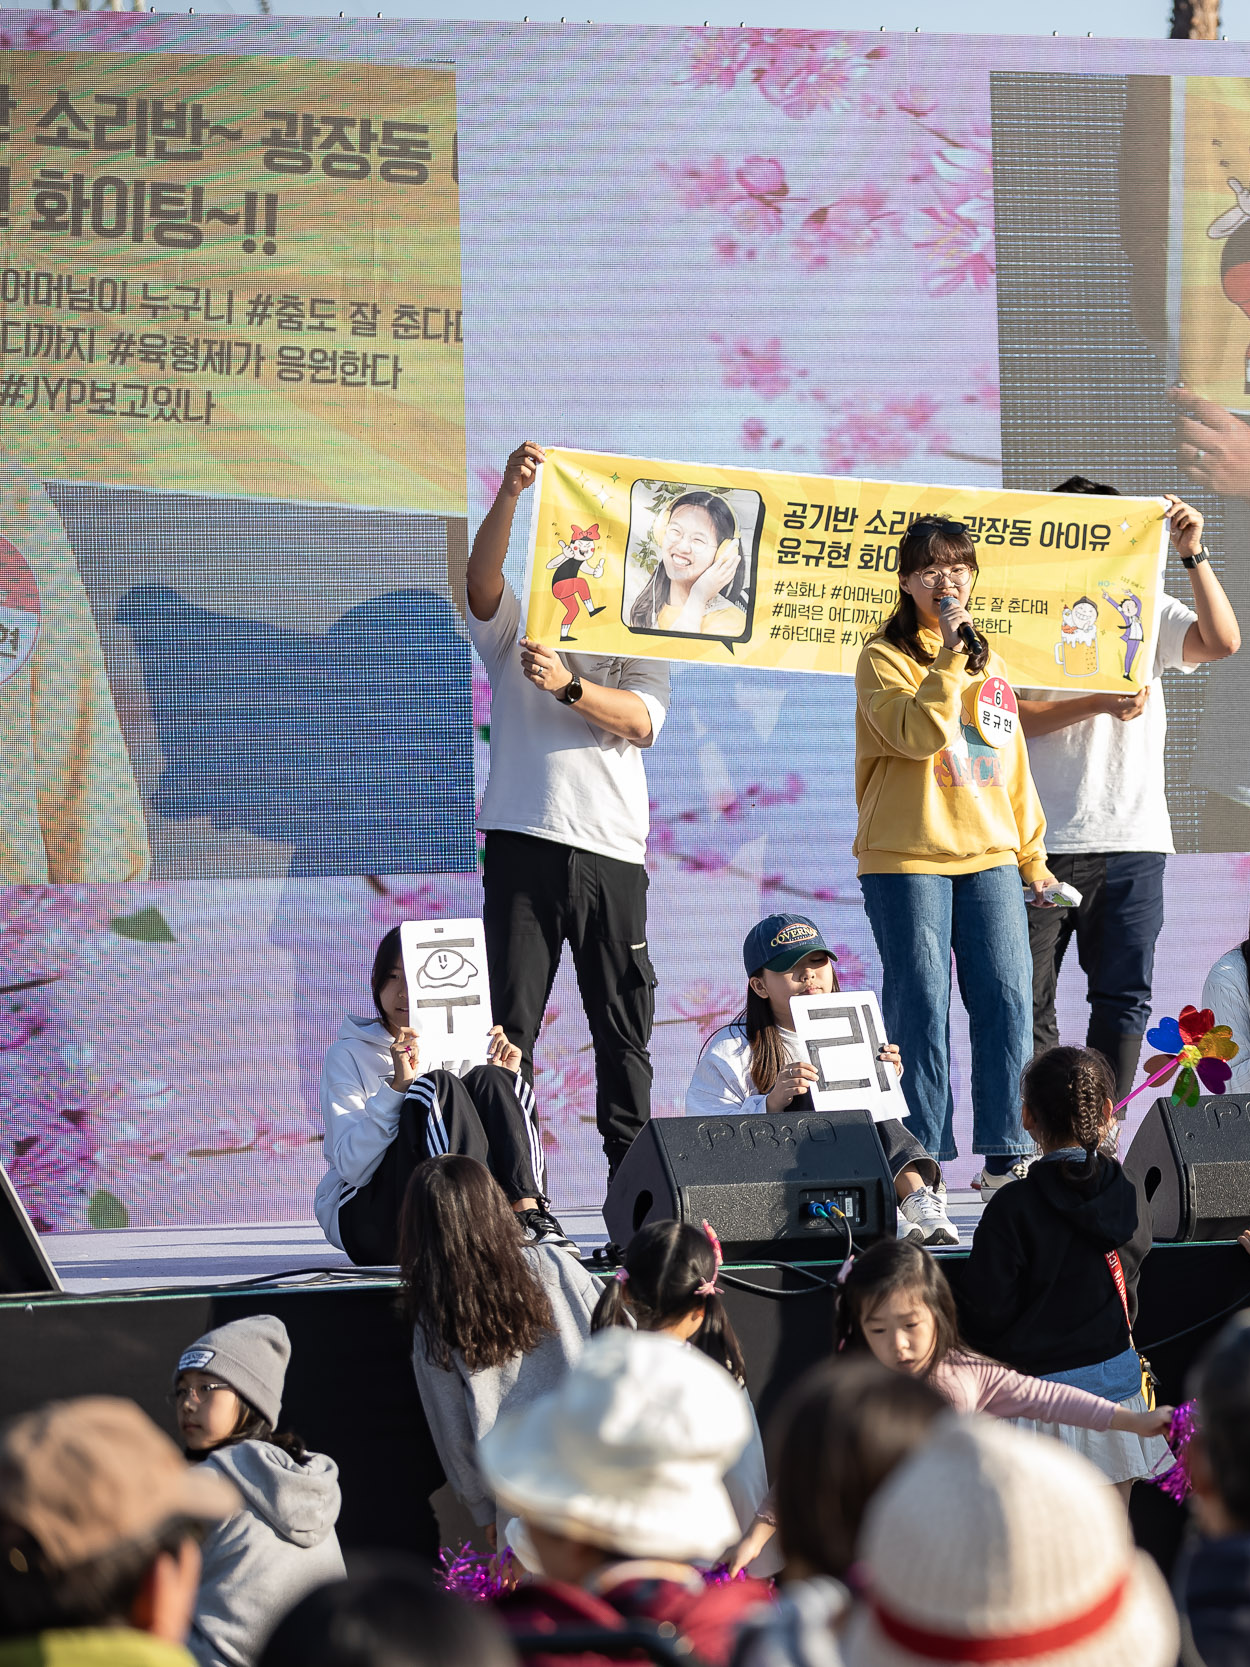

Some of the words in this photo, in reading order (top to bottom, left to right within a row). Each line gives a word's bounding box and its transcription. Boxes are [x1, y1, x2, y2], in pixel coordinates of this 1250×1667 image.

[35, 90, 243, 162] 소리반~
[259, 109, 432, 185] 광장동
[30, 169, 279, 256] 화이팅~!!
[140, 283, 234, 326] 누구니
[246, 293, 337, 333] #춤도
[349, 301, 381, 338] 잘
[108, 332, 266, 379] #육형제가
[276, 345, 402, 390] 응원한다
[0, 374, 216, 424] #JYP보고있나
[783, 501, 859, 533] 공기반
[1039, 521, 1112, 552] 아이유
[777, 537, 852, 569] 윤규현
[771, 602, 824, 621] #매력은
[828, 606, 883, 625] 어디까지
[774, 580, 826, 599] #실화냐
[831, 585, 899, 605] #어머님이
[990, 597, 1005, 613] 잘
[1008, 598, 1048, 615] 춘다며
[769, 624, 836, 645] #하던대로
[983, 710, 1012, 733] 윤규현
[995, 692, 1001, 706] 6
[805, 1004, 892, 1093] 리
